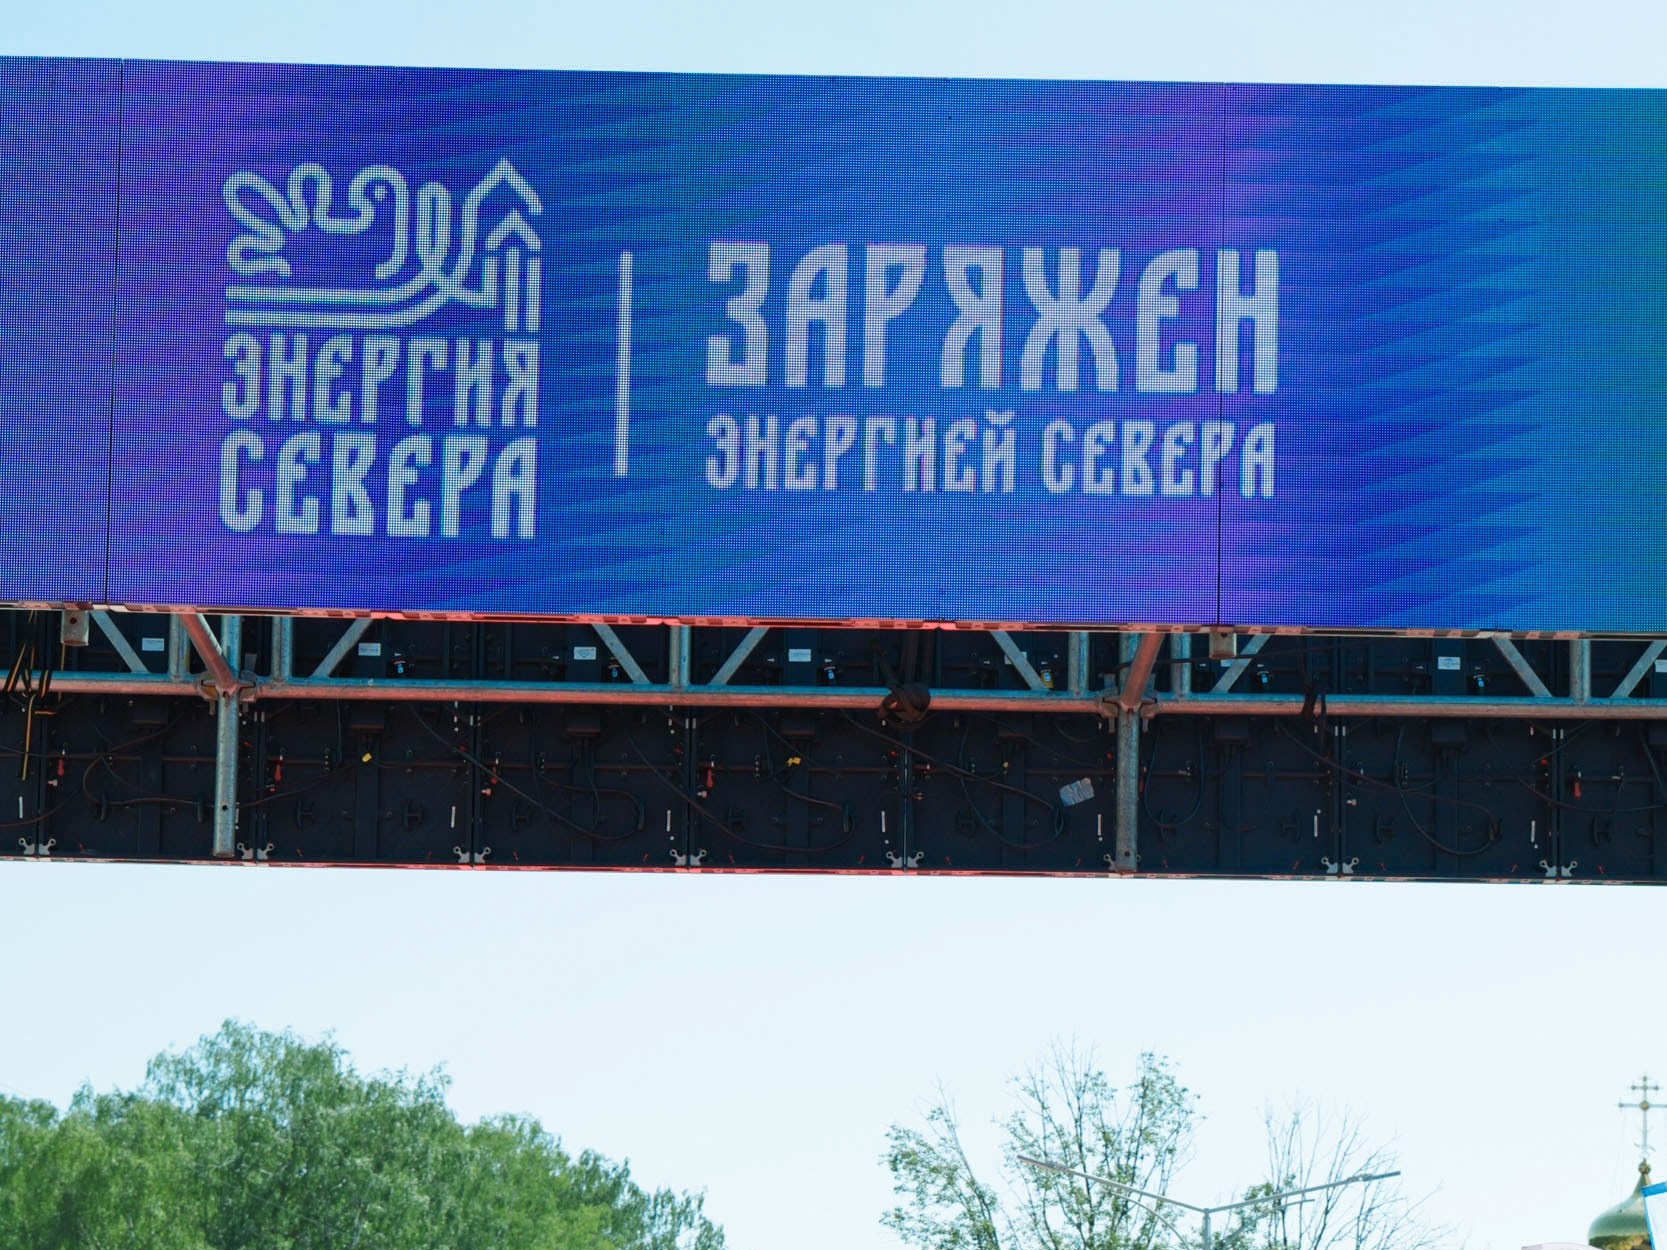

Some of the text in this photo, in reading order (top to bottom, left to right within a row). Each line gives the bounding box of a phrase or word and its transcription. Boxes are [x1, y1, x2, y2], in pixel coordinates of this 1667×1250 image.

[704, 240, 1279, 394] ЗАРЯЖЕН
[221, 331, 541, 427] ЭНЕРГИЯ
[219, 428, 538, 538] СЕВЕРА
[704, 410, 1277, 498] ЭНЕРГИЕЙ СЕВЕРА
